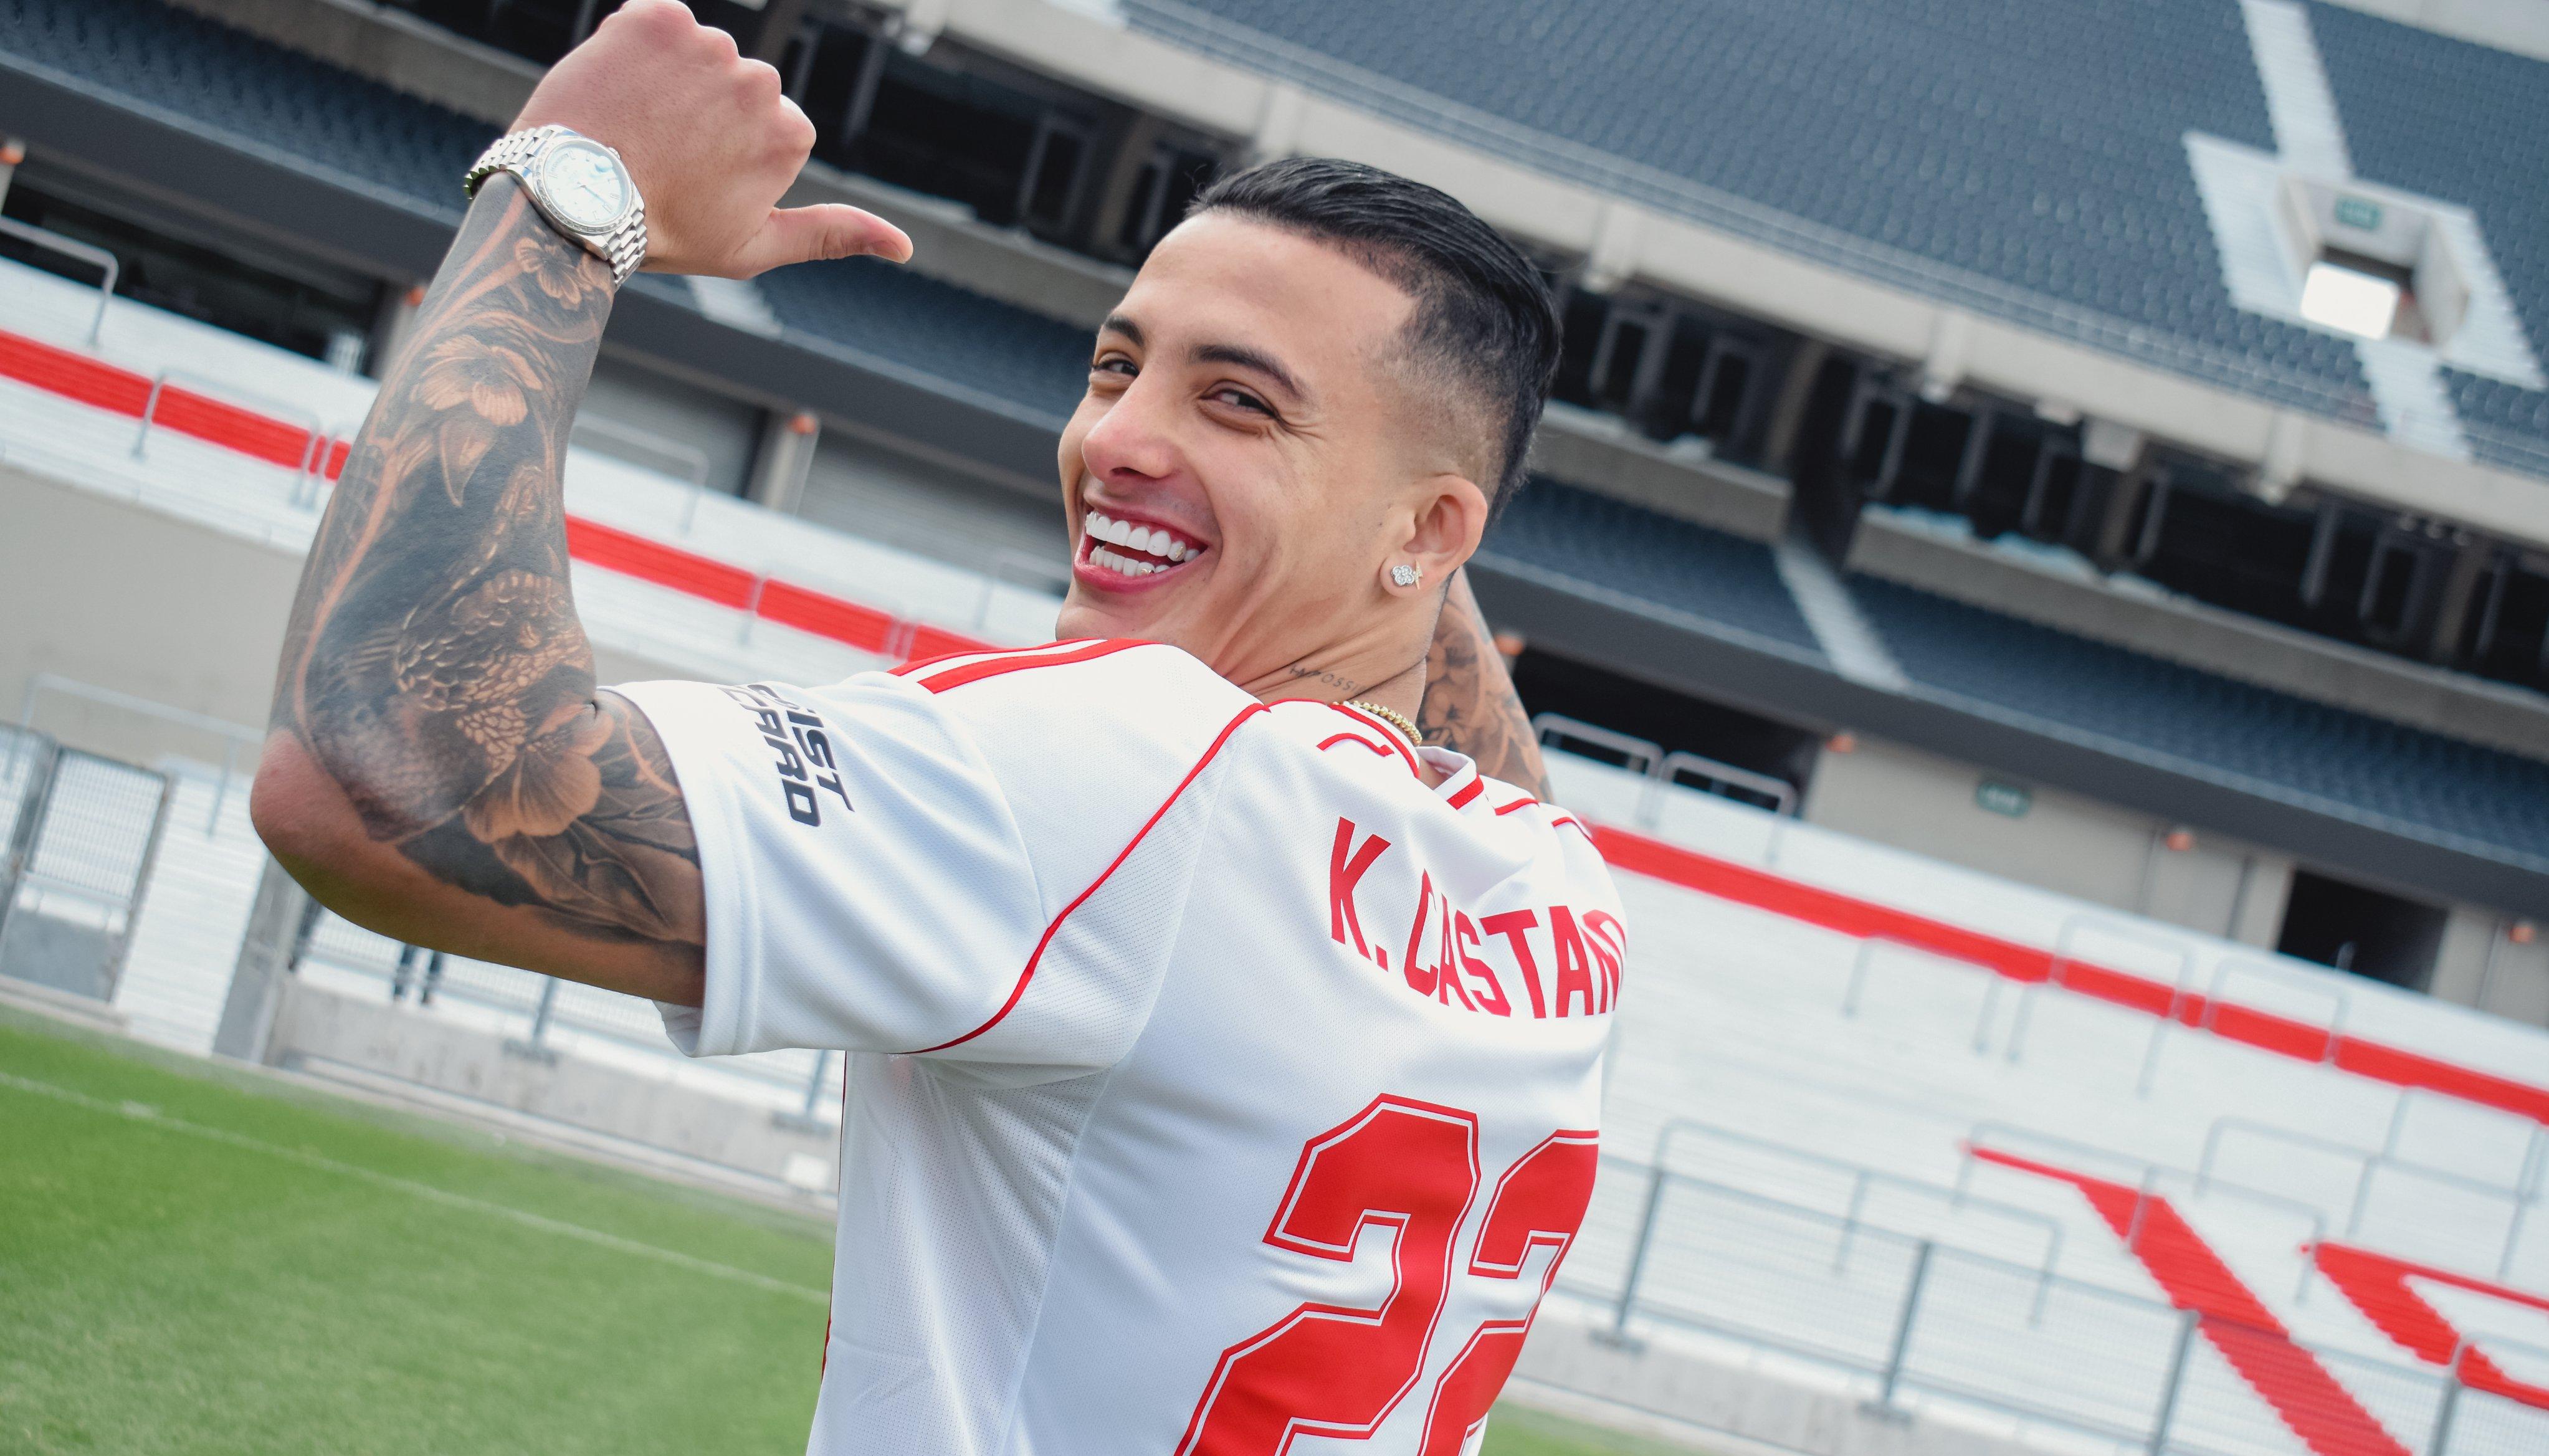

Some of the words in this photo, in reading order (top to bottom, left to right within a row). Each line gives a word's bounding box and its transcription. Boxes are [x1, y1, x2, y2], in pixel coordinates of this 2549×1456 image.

[717, 687, 821, 827] CARD
[1330, 817, 1391, 972] K.
[1174, 1093, 1599, 1456] 22
